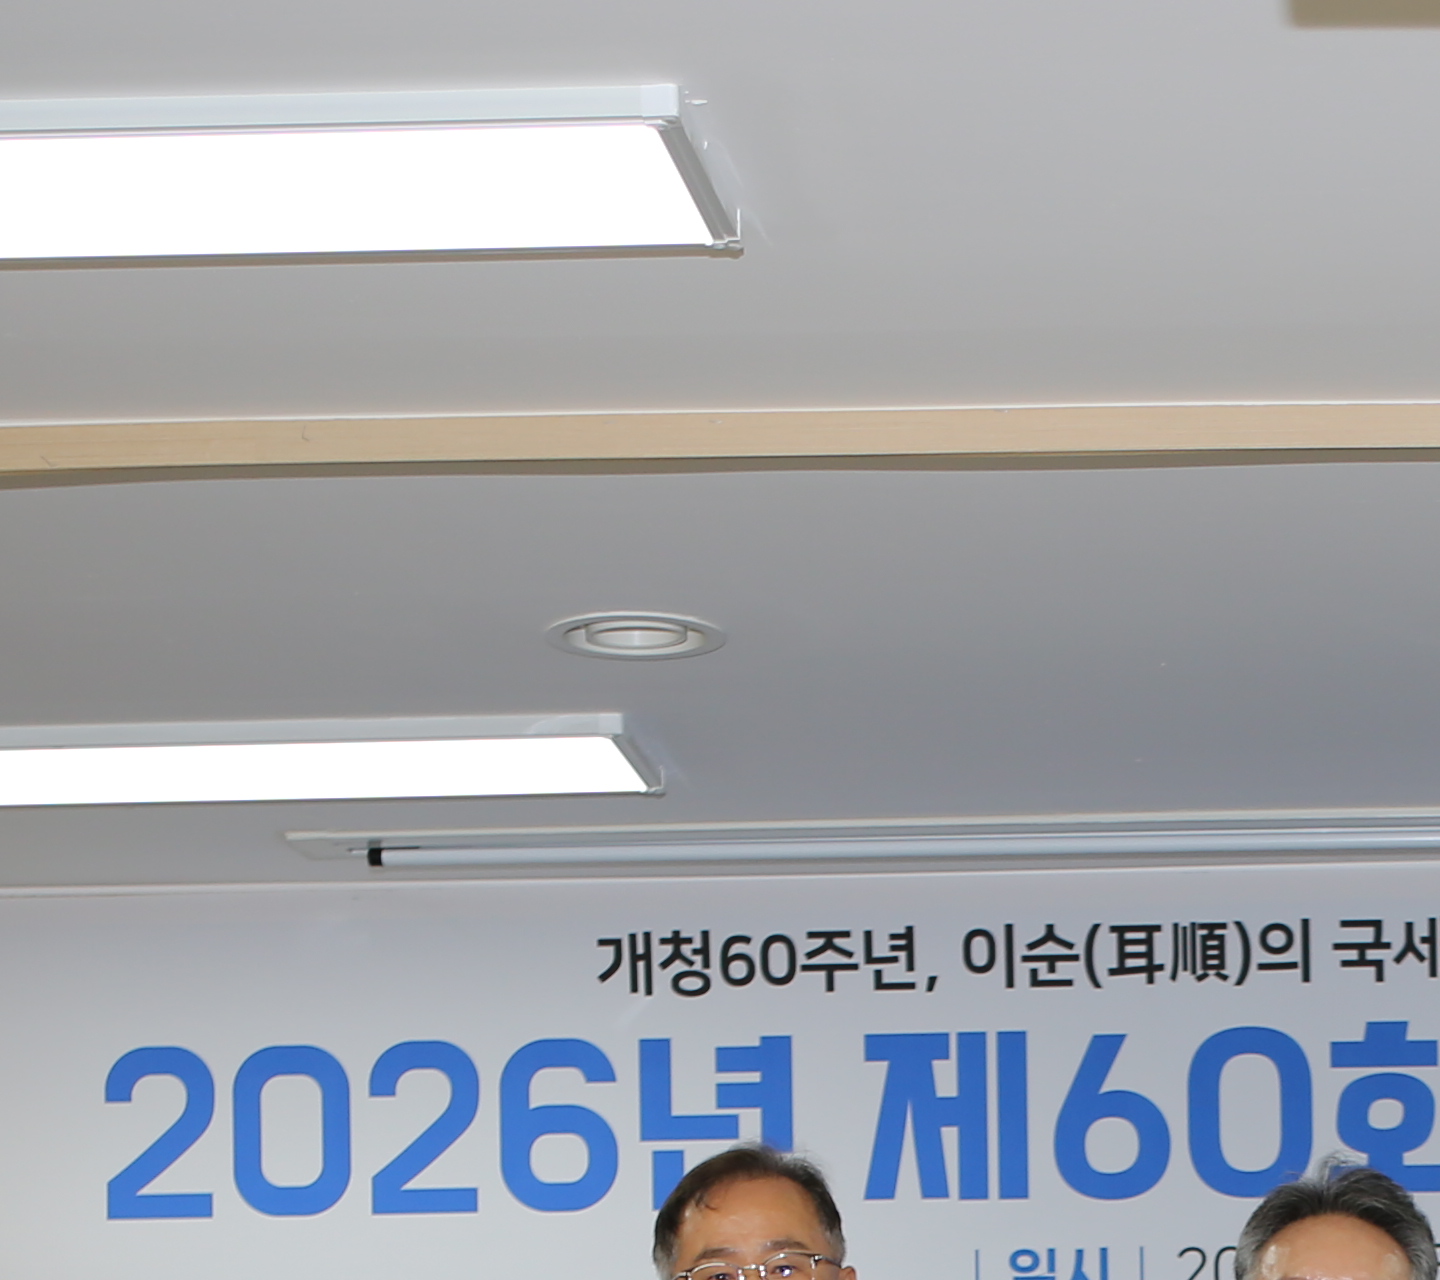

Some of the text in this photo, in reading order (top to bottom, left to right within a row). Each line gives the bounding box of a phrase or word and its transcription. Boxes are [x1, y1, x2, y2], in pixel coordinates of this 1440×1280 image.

[596, 924, 939, 997] 개청60주년,
[962, 917, 1313, 990] 이순(耳順)의
[104, 1034, 793, 1219] 2026년
